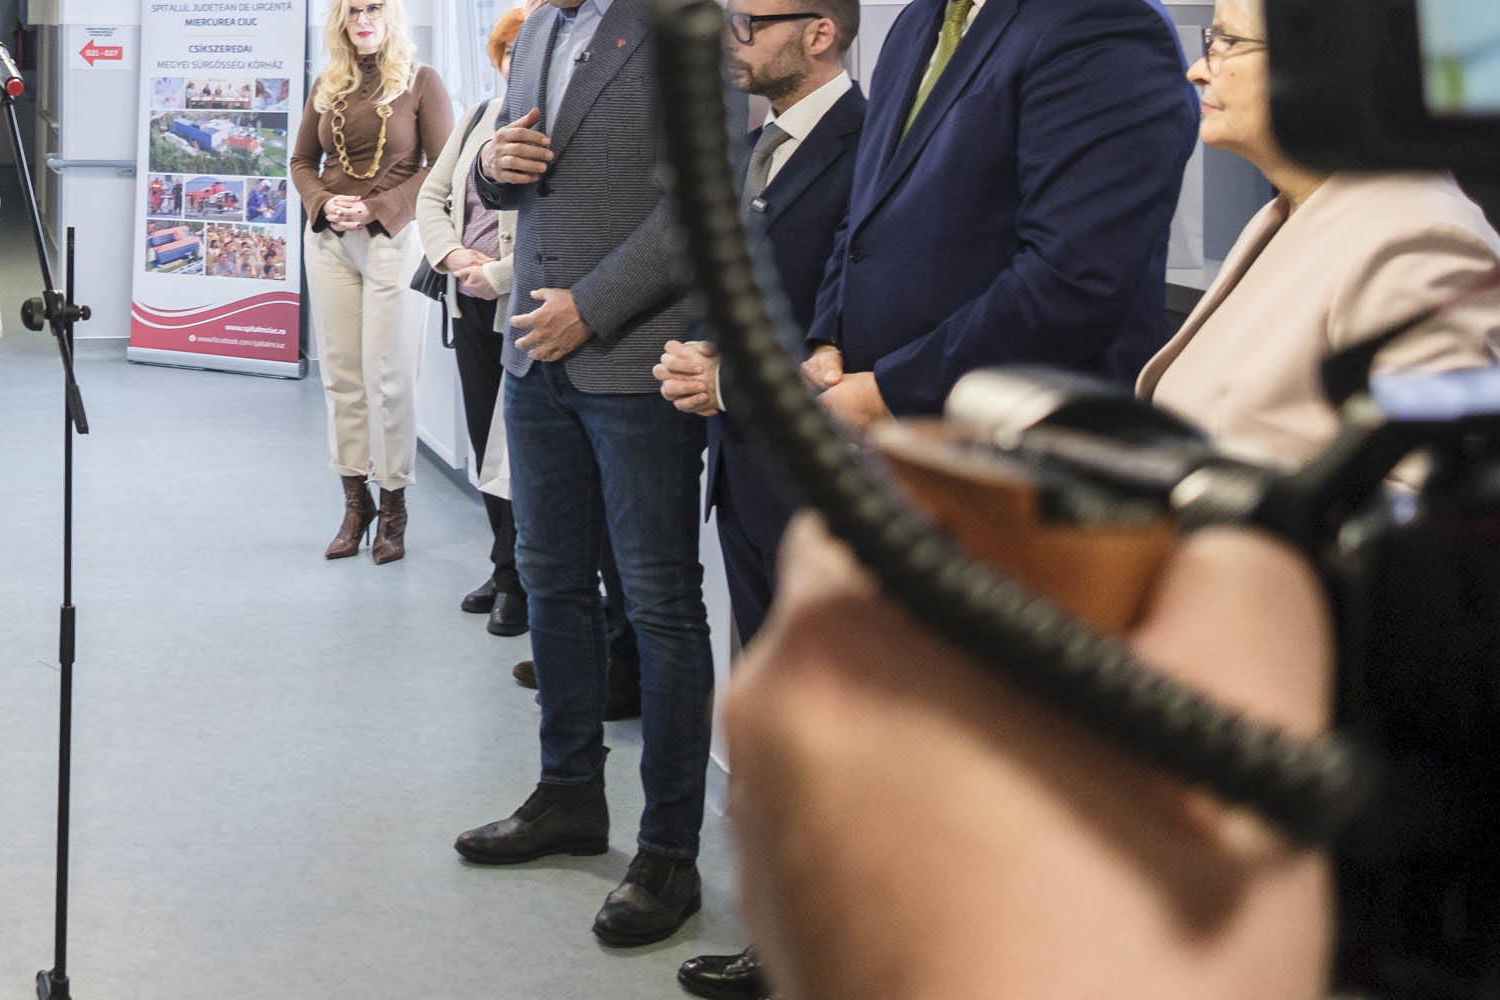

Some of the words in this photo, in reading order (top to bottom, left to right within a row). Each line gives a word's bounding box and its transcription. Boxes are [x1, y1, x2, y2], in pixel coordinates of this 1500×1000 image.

[151, 4, 190, 13] SPITALUL
[239, 3, 249, 11] DE
[184, 18, 236, 26] MIERCUREA
[238, 18, 257, 26] CIUC
[156, 60, 190, 70] MEGYEI
